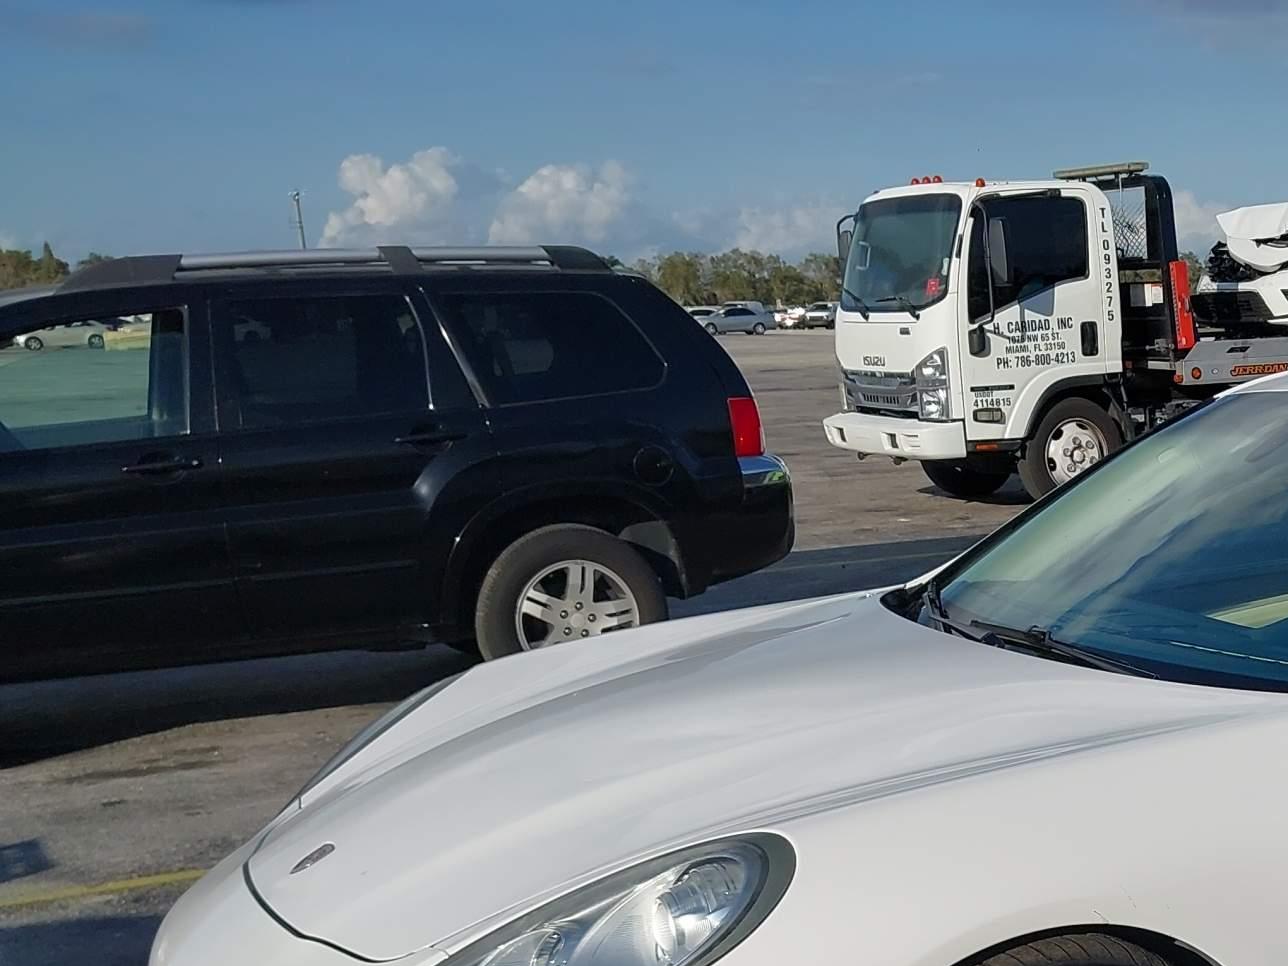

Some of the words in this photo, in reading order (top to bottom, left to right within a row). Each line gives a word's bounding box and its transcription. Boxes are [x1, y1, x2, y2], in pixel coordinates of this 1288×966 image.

[1099, 207, 1108, 233] TL
[1102, 239, 1115, 322] 093275
[993, 322, 1004, 335] H.
[1007, 318, 1054, 334] CARIDAD,
[1057, 317, 1073, 330] INC
[1026, 333, 1039, 343] NW
[1040, 332, 1050, 342] 65
[1051, 331, 1062, 341] ST.
[1005, 344, 1031, 354] MIAMI,
[1034, 343, 1042, 353] FL
[1044, 341, 1066, 352] 33150
[863, 356, 885, 367] ISUZU
[996, 357, 1012, 369] PH:
[1015, 352, 1076, 368] 786-800-4213
[973, 397, 1012, 408] 4114815
